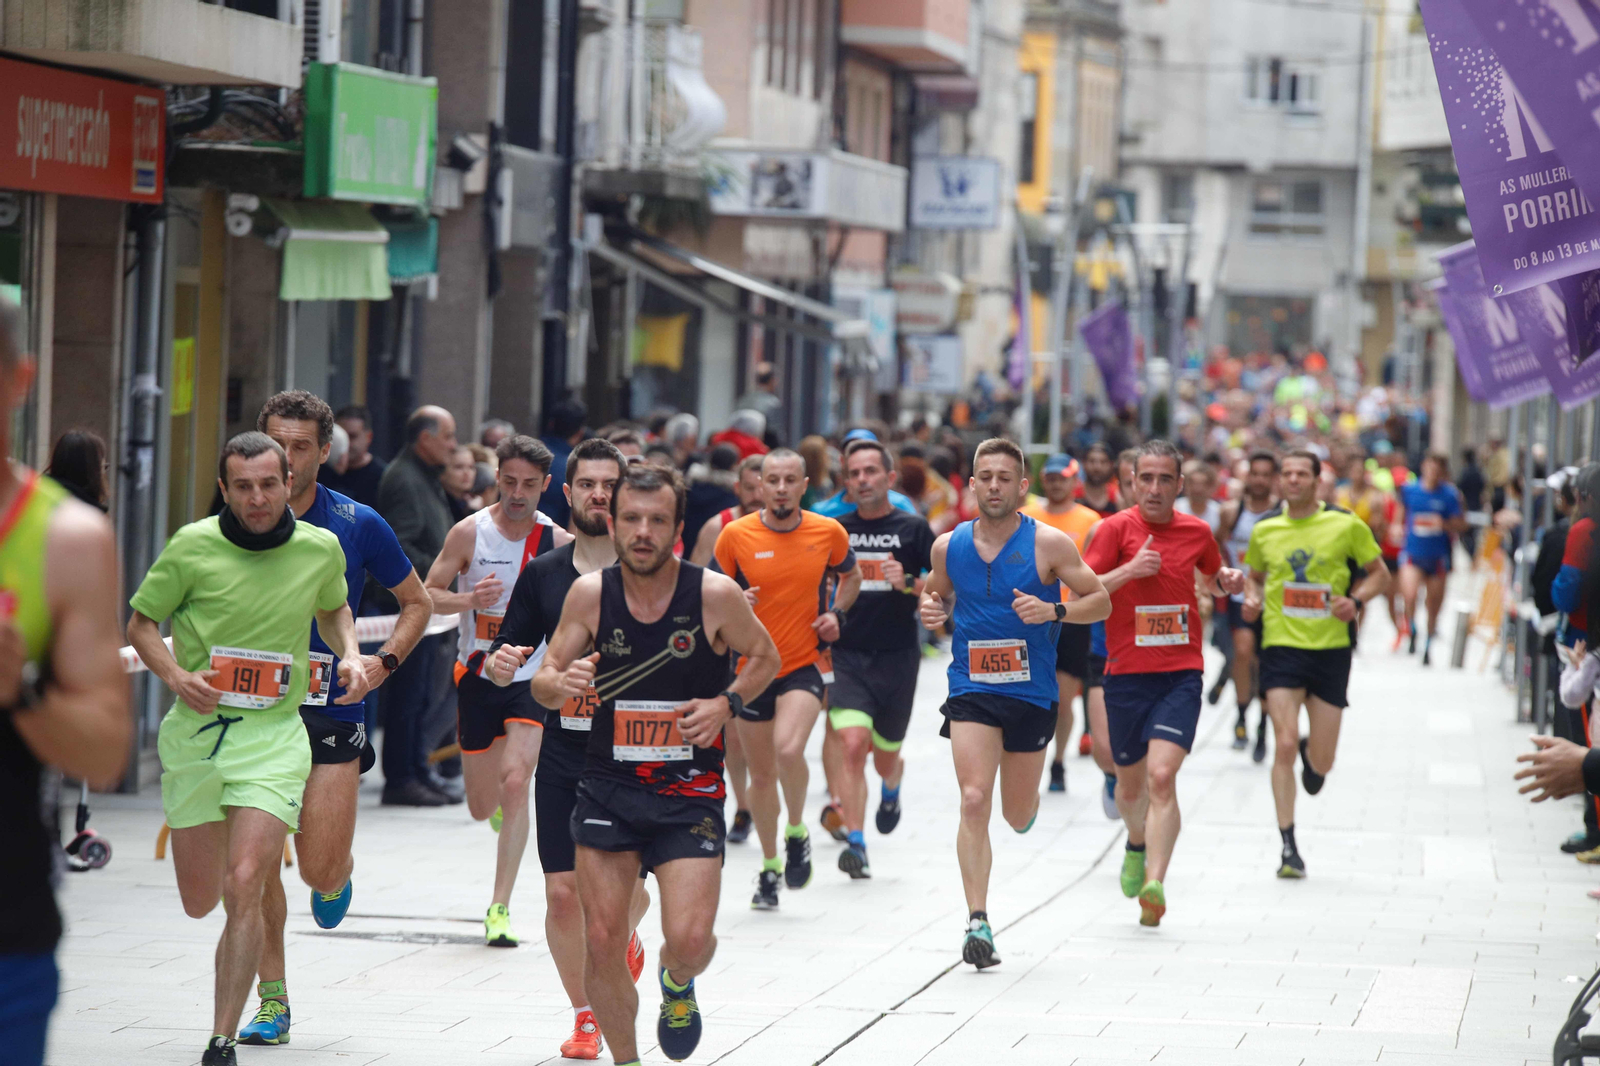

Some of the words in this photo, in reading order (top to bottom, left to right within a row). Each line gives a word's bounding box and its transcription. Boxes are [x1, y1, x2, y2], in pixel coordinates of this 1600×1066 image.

[16, 89, 110, 179] supermercado
[1500, 178, 1517, 196] AS
[1513, 256, 1529, 270] DO
[1530, 251, 1539, 266] 8
[1542, 250, 1555, 263] AO
[1557, 243, 1573, 259] 13
[1574, 241, 1589, 255] DE
[1590, 238, 1600, 251] M
[330, 505, 357, 524] adidas
[848, 533, 902, 548] BANCA
[1147, 617, 1173, 635] 752
[980, 653, 1011, 672] 455
[232, 667, 261, 694] 191
[573, 695, 597, 717] 25
[626, 720, 672, 745] 1077
